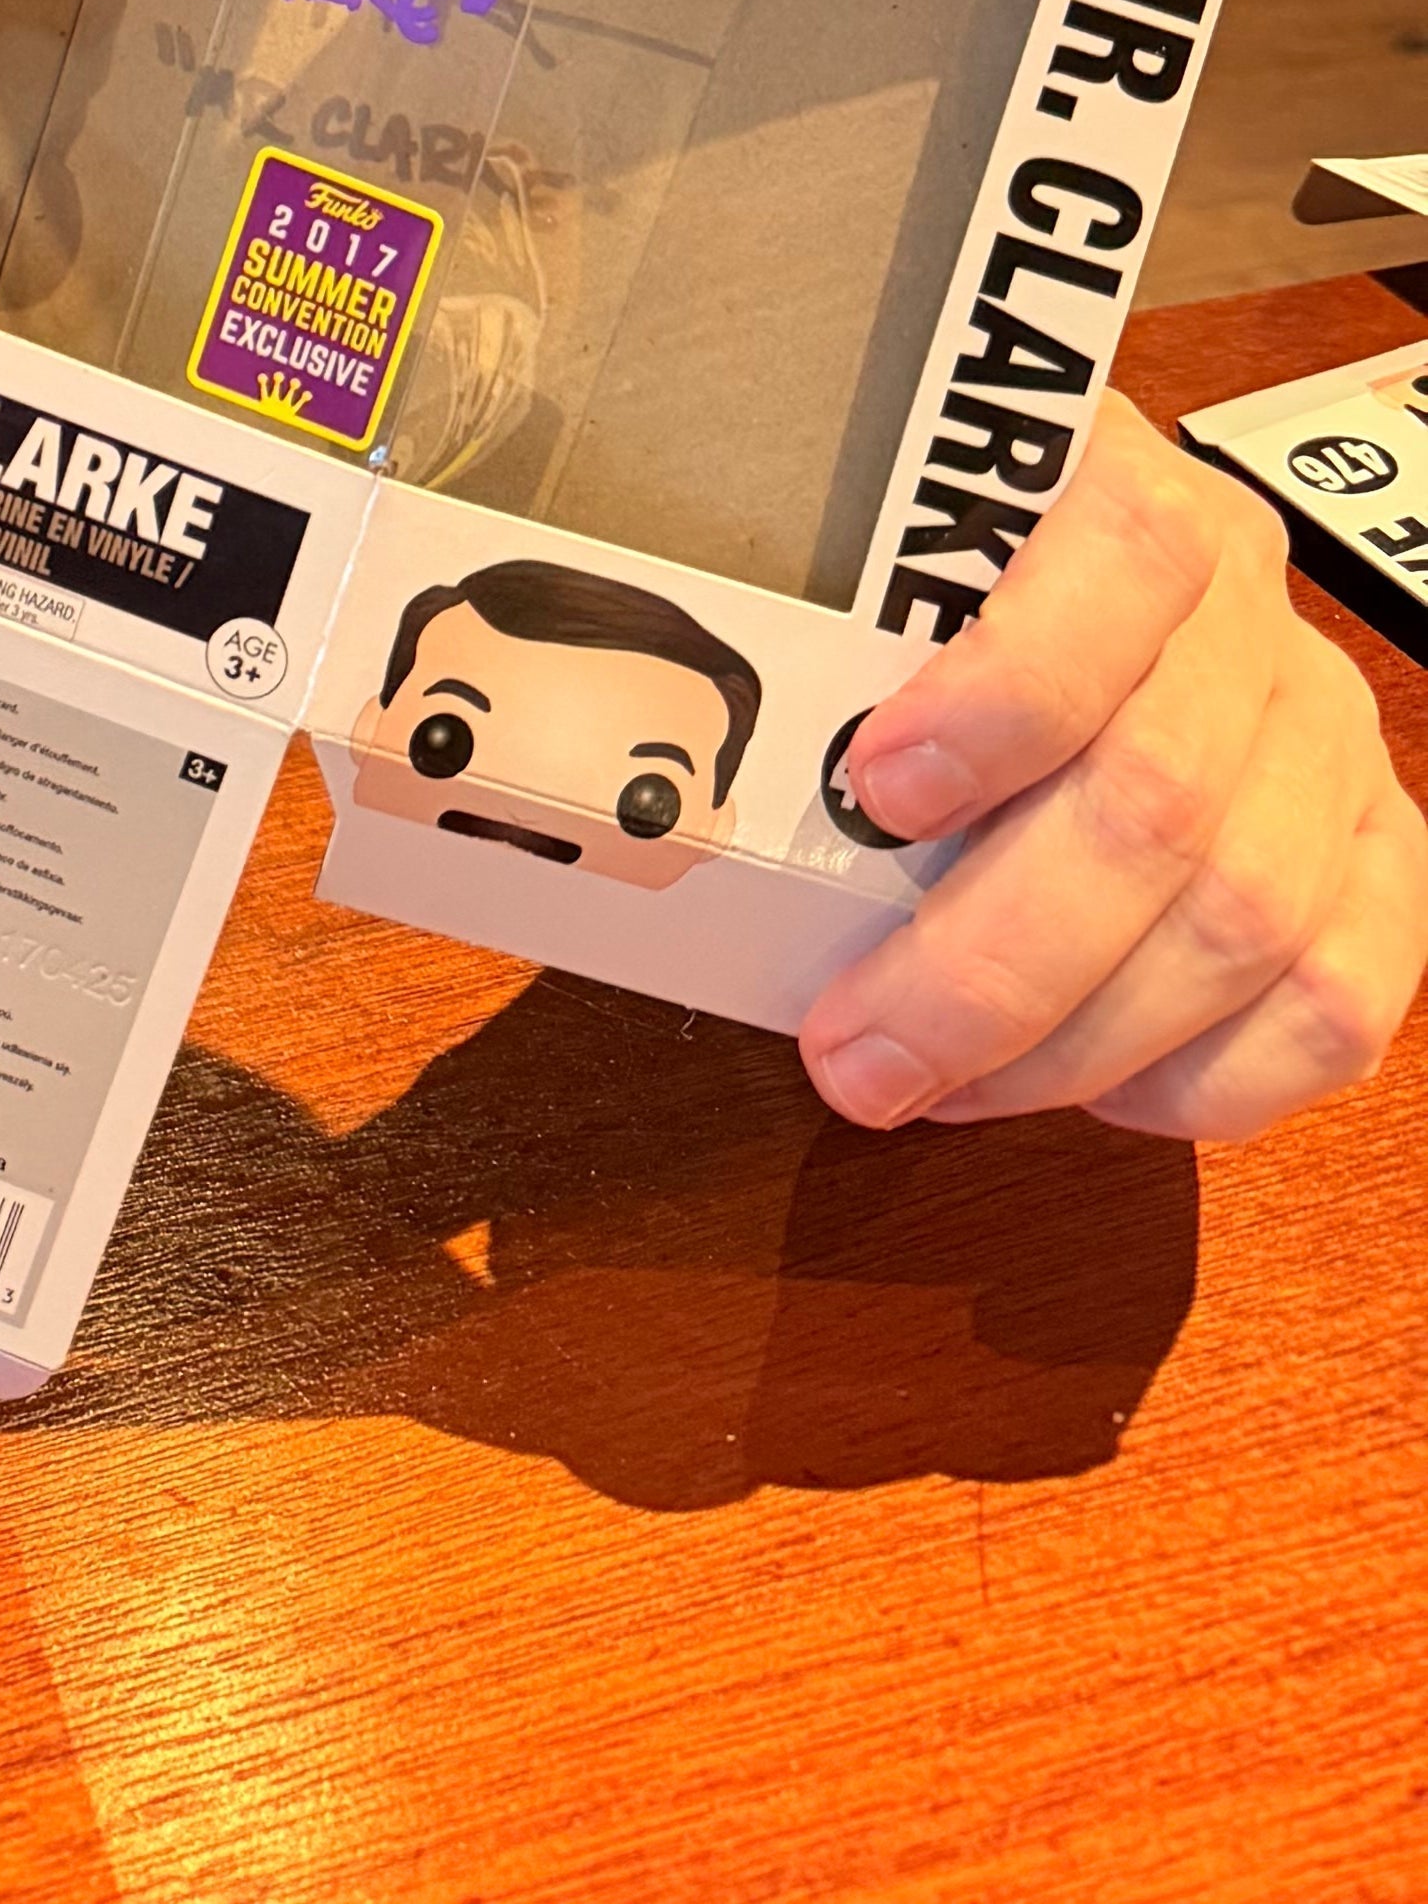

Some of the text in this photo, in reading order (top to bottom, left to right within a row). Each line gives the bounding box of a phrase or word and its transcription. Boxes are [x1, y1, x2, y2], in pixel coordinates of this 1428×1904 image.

[303, 181, 383, 230] Funko
[242, 237, 397, 329] SUMMER
[230, 274, 388, 360] CONVENTION
[218, 308, 375, 396] EXCLUSIVE
[875, 157, 1144, 645] CLARKE
[1292, 438, 1392, 491] 476
[45, 510, 85, 549] EN
[86, 524, 176, 583] VINYLE
[10, 603, 20, 617] 3
[17, 586, 76, 623] HAZARD.
[222, 628, 278, 665] AGE
[223, 654, 261, 683] 3+
[186, 757, 217, 784] 3+
[0, 1286, 15, 1304] 3
